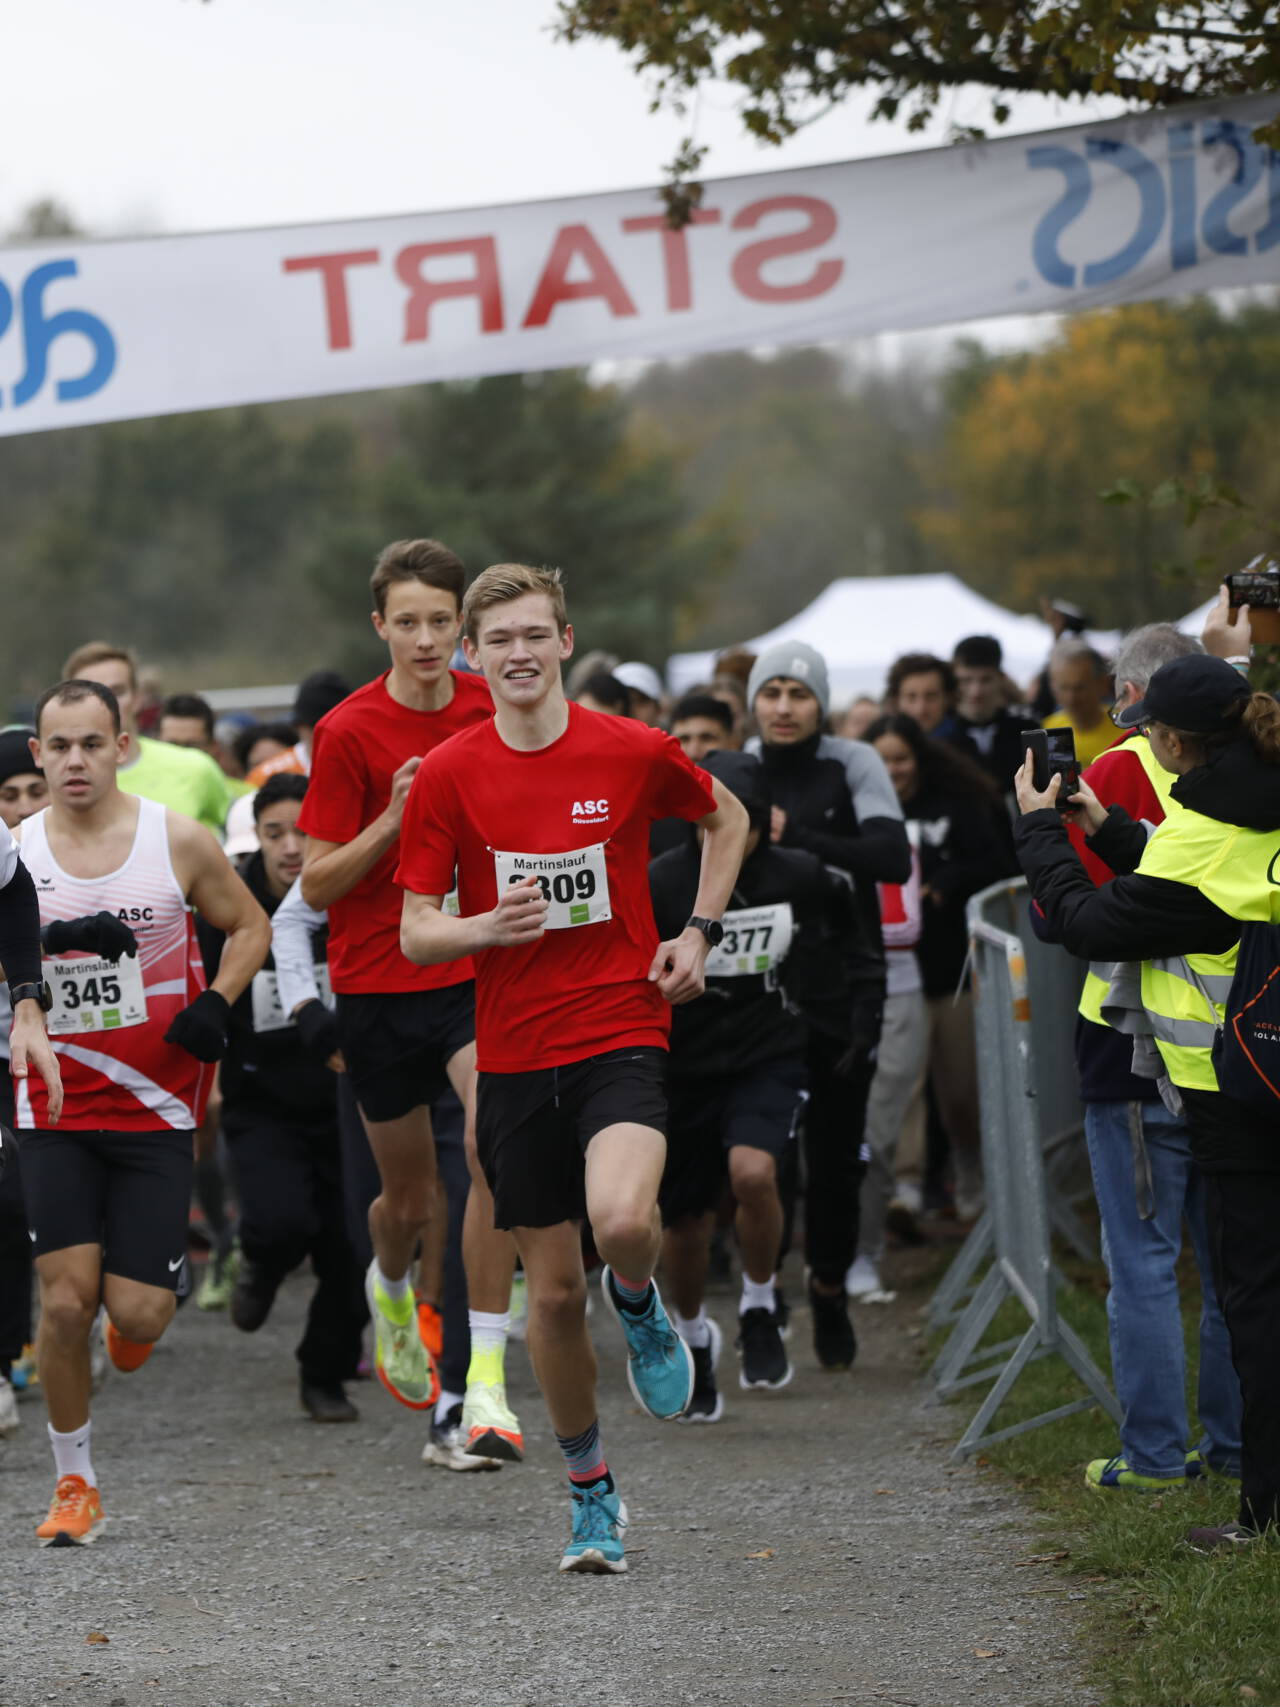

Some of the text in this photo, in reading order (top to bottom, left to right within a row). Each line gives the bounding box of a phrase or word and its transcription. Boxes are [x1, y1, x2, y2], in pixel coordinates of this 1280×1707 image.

[571, 799, 609, 816] ASC
[514, 853, 586, 871] Martinslauf
[118, 907, 153, 922] ASC
[723, 925, 773, 955] 377
[61, 975, 122, 1009] 345
